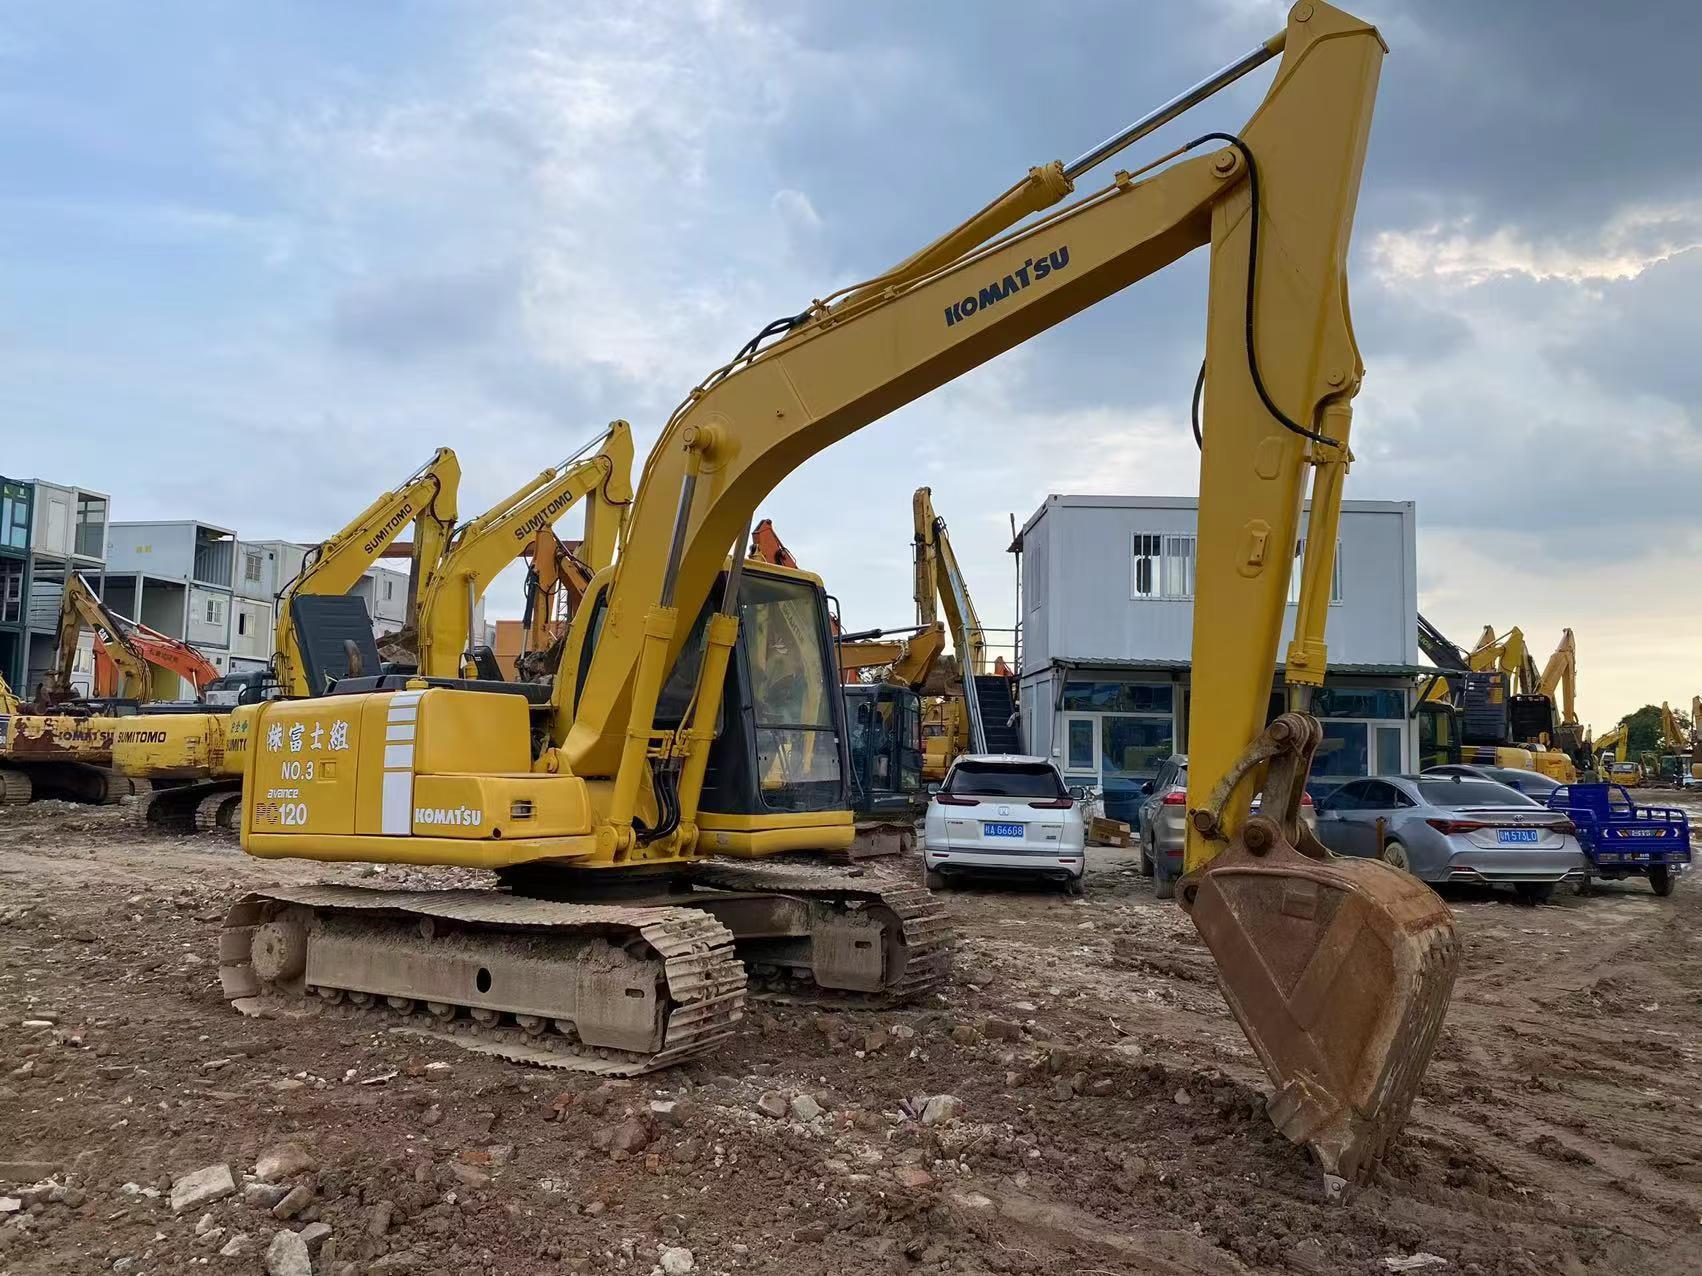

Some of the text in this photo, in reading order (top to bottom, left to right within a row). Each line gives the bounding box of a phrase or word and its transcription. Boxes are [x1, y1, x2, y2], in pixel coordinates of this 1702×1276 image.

[944, 245, 1070, 327] KOMATSU
[514, 490, 573, 541] SUMITOMO
[364, 503, 413, 554] SUMITOMO
[117, 731, 167, 743] SUMITOMO
[281, 761, 314, 780] NO.3
[267, 788, 299, 799] avance
[255, 802, 308, 825] PC120
[415, 805, 482, 826] KOMATSU
